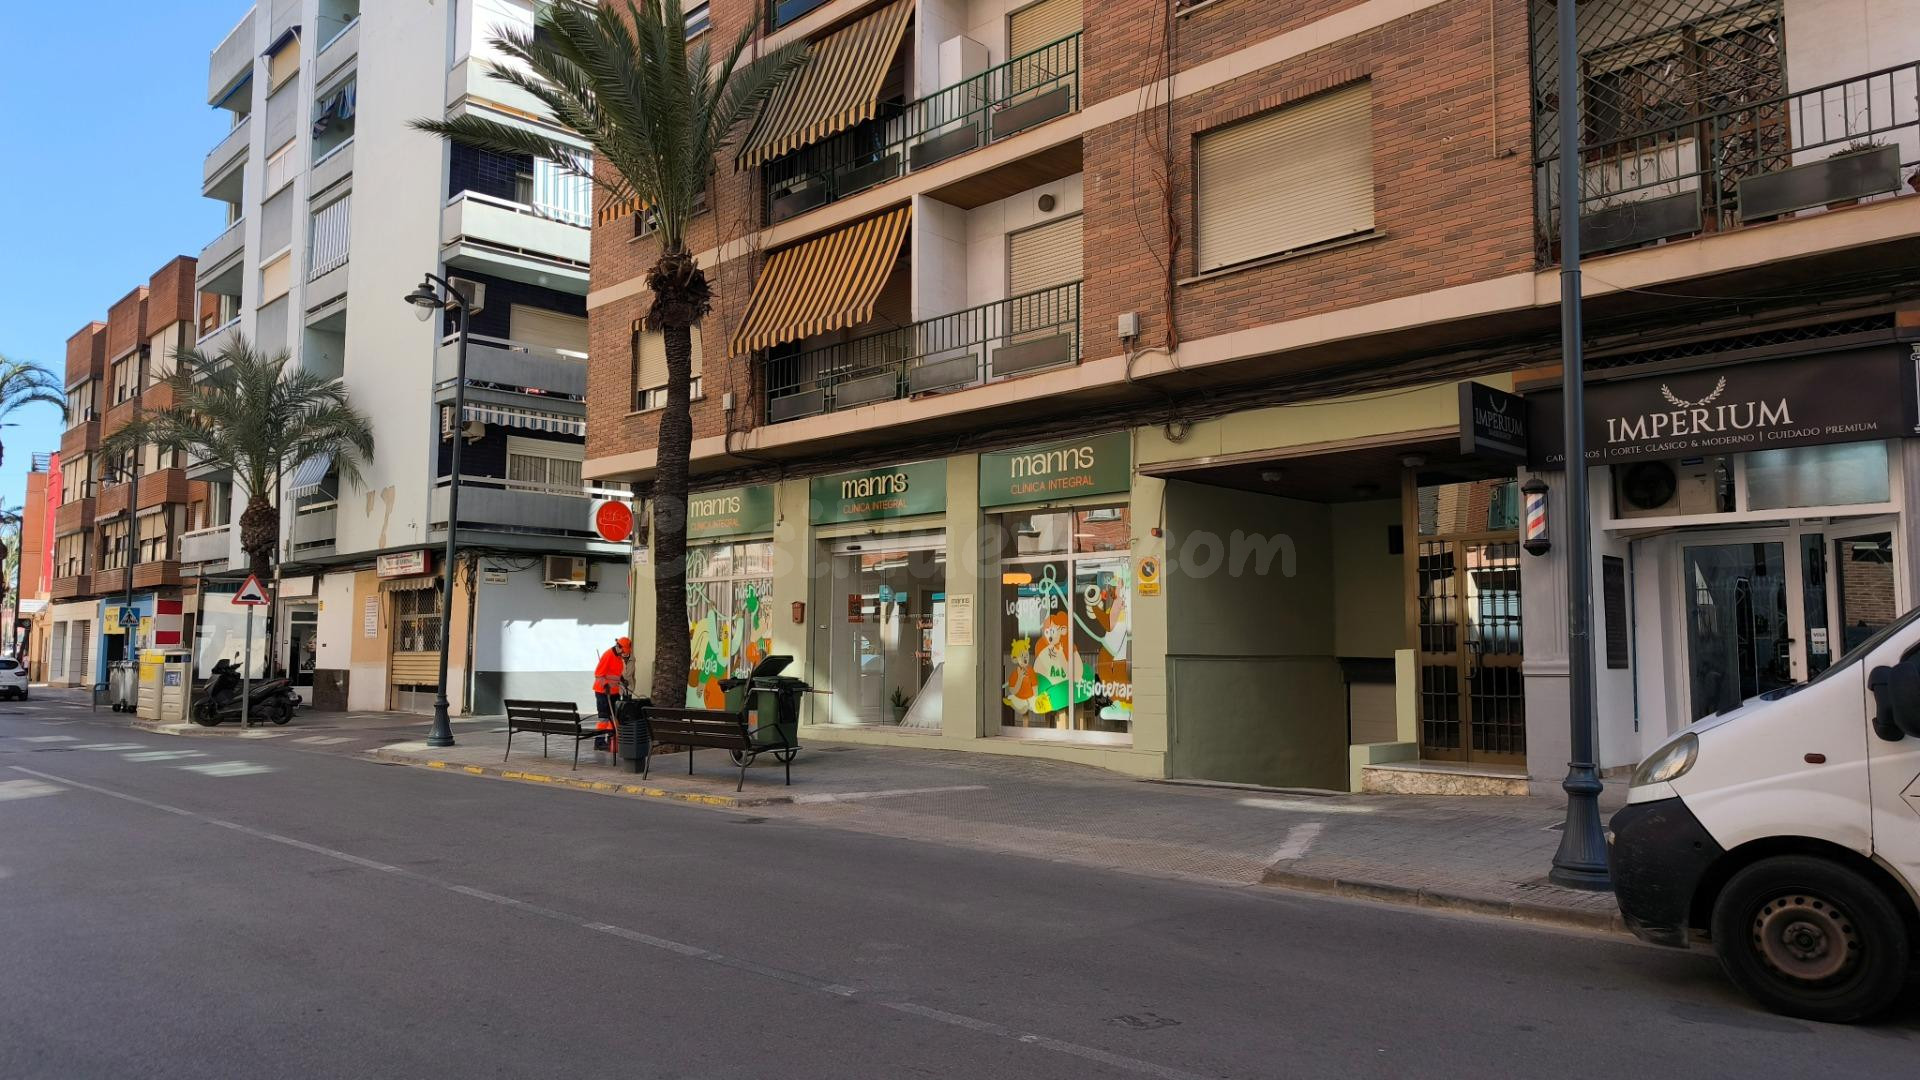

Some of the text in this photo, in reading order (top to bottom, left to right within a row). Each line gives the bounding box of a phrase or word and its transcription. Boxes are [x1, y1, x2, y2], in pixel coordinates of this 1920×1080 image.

[1475, 407, 1524, 436] IMPERIUM
[1606, 397, 1794, 444] IMPERIUM
[1545, 422, 1878, 463] CABROS CORTE CLASICO & MODERNO CUIDADO PREMIUM
[1010, 446, 1095, 478] manns
[842, 472, 907, 499] manns
[1048, 475, 1095, 491] INTEGRAL
[690, 496, 740, 517] manns
[872, 498, 908, 511] INTEGRAL
